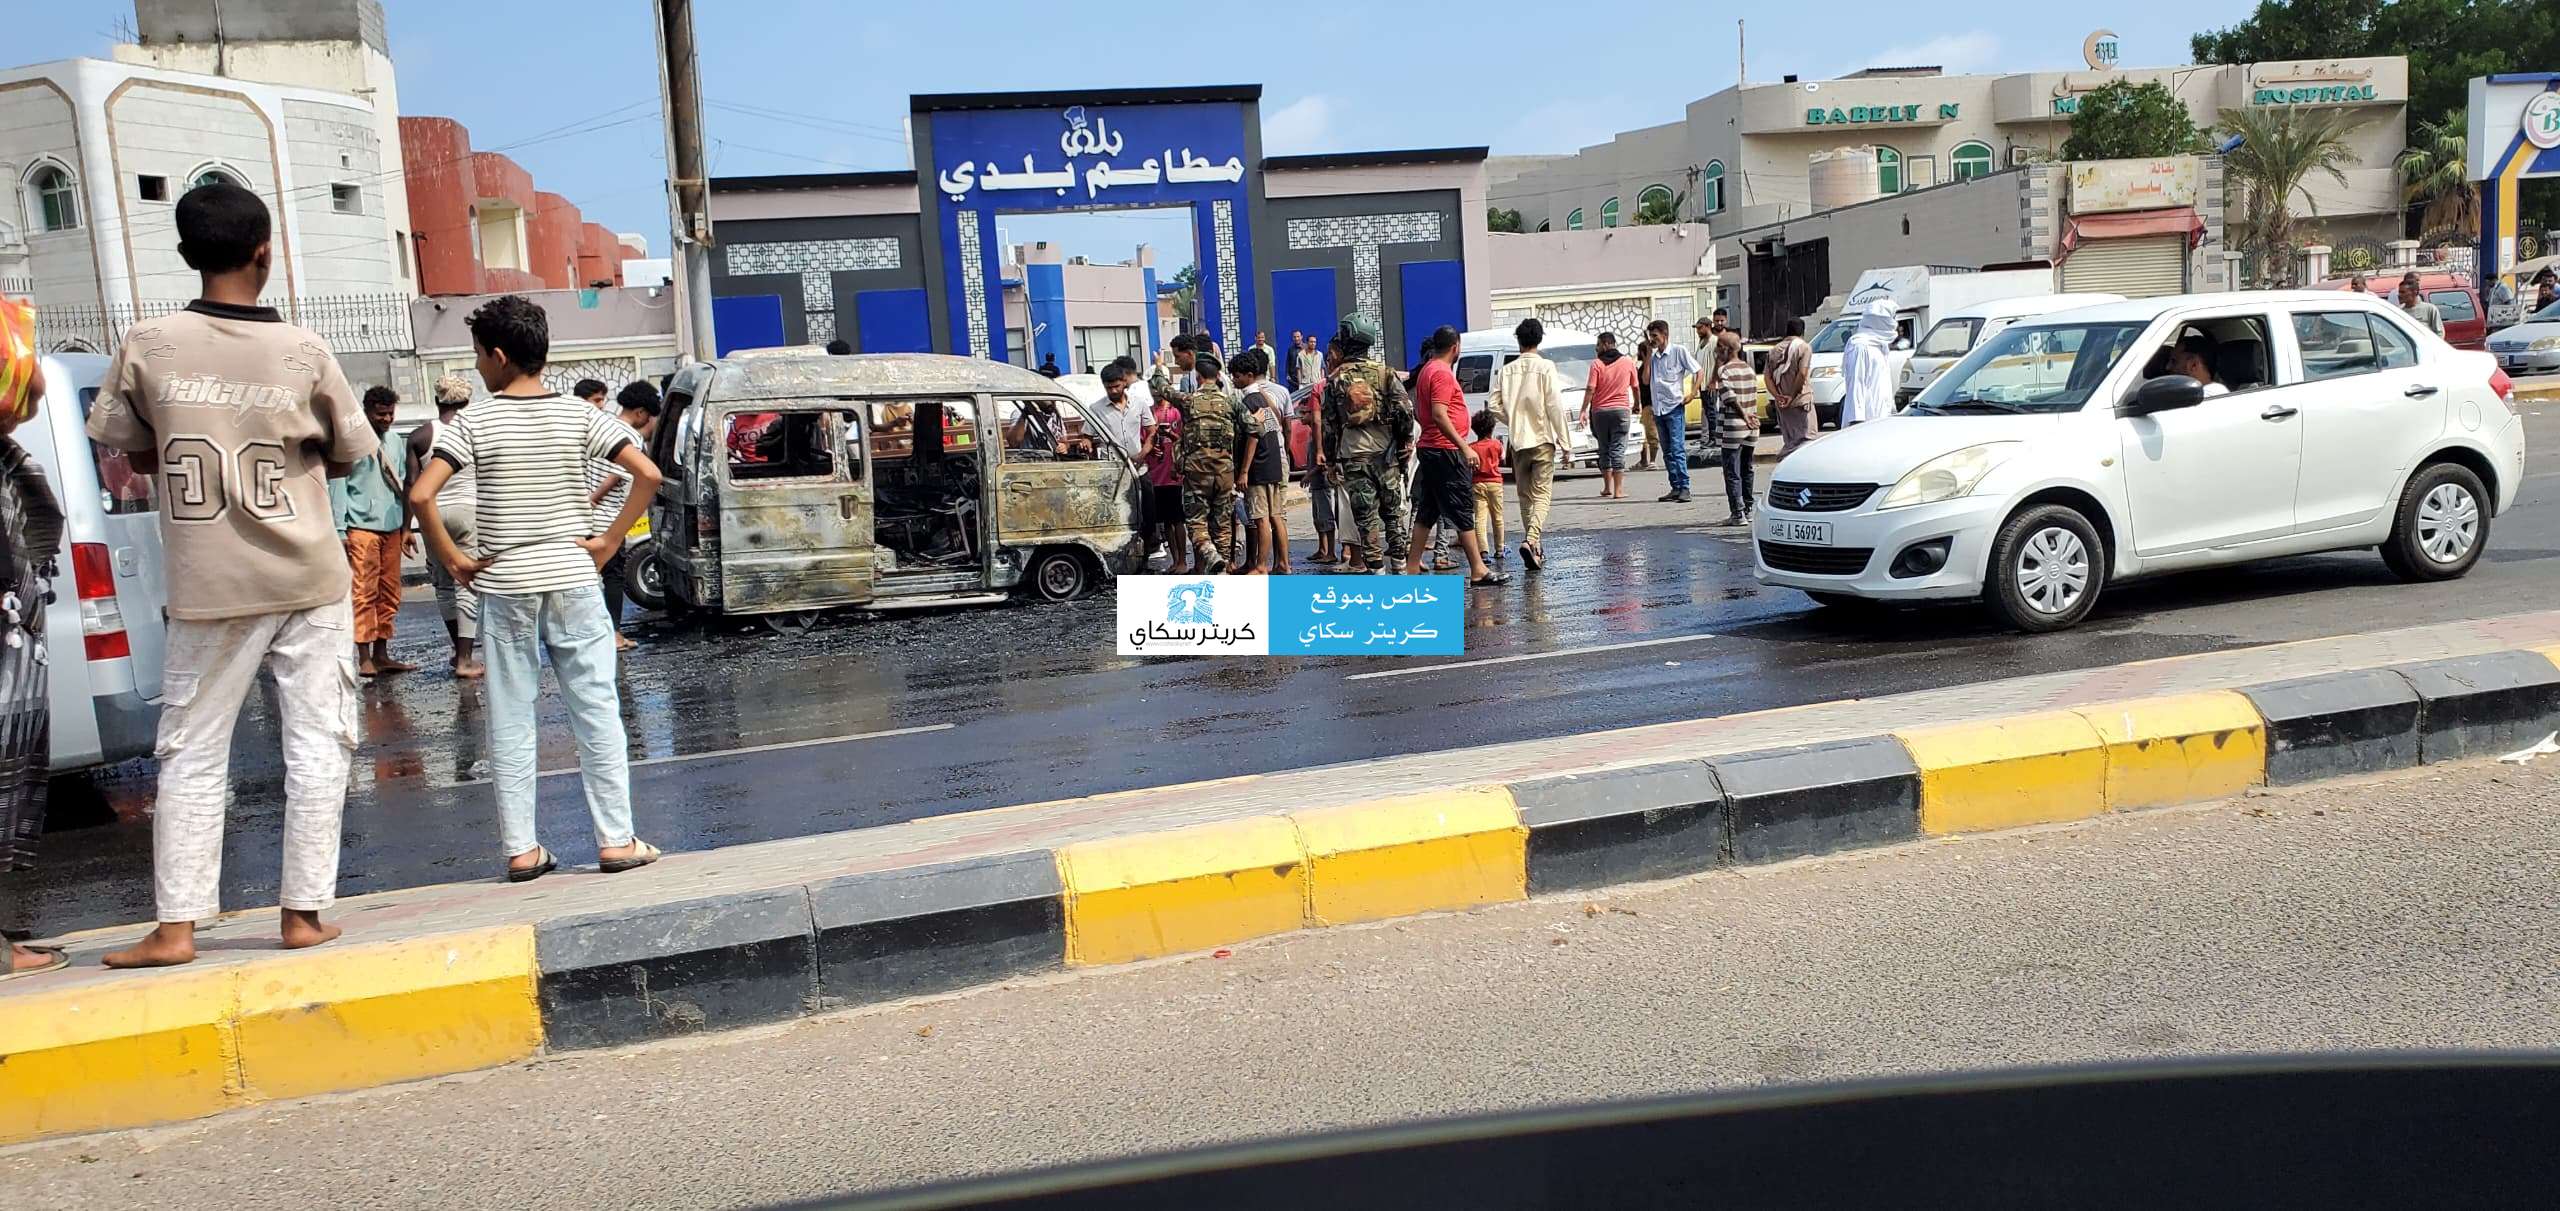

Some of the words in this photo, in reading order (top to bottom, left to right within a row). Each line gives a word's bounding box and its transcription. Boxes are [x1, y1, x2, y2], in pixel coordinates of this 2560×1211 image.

[2254, 85, 2379, 105] HOSPITAL
[939, 153, 1075, 202] بلدي
[1086, 147, 1244, 199] مطاعم
[1794, 524, 1823, 541] 56991
